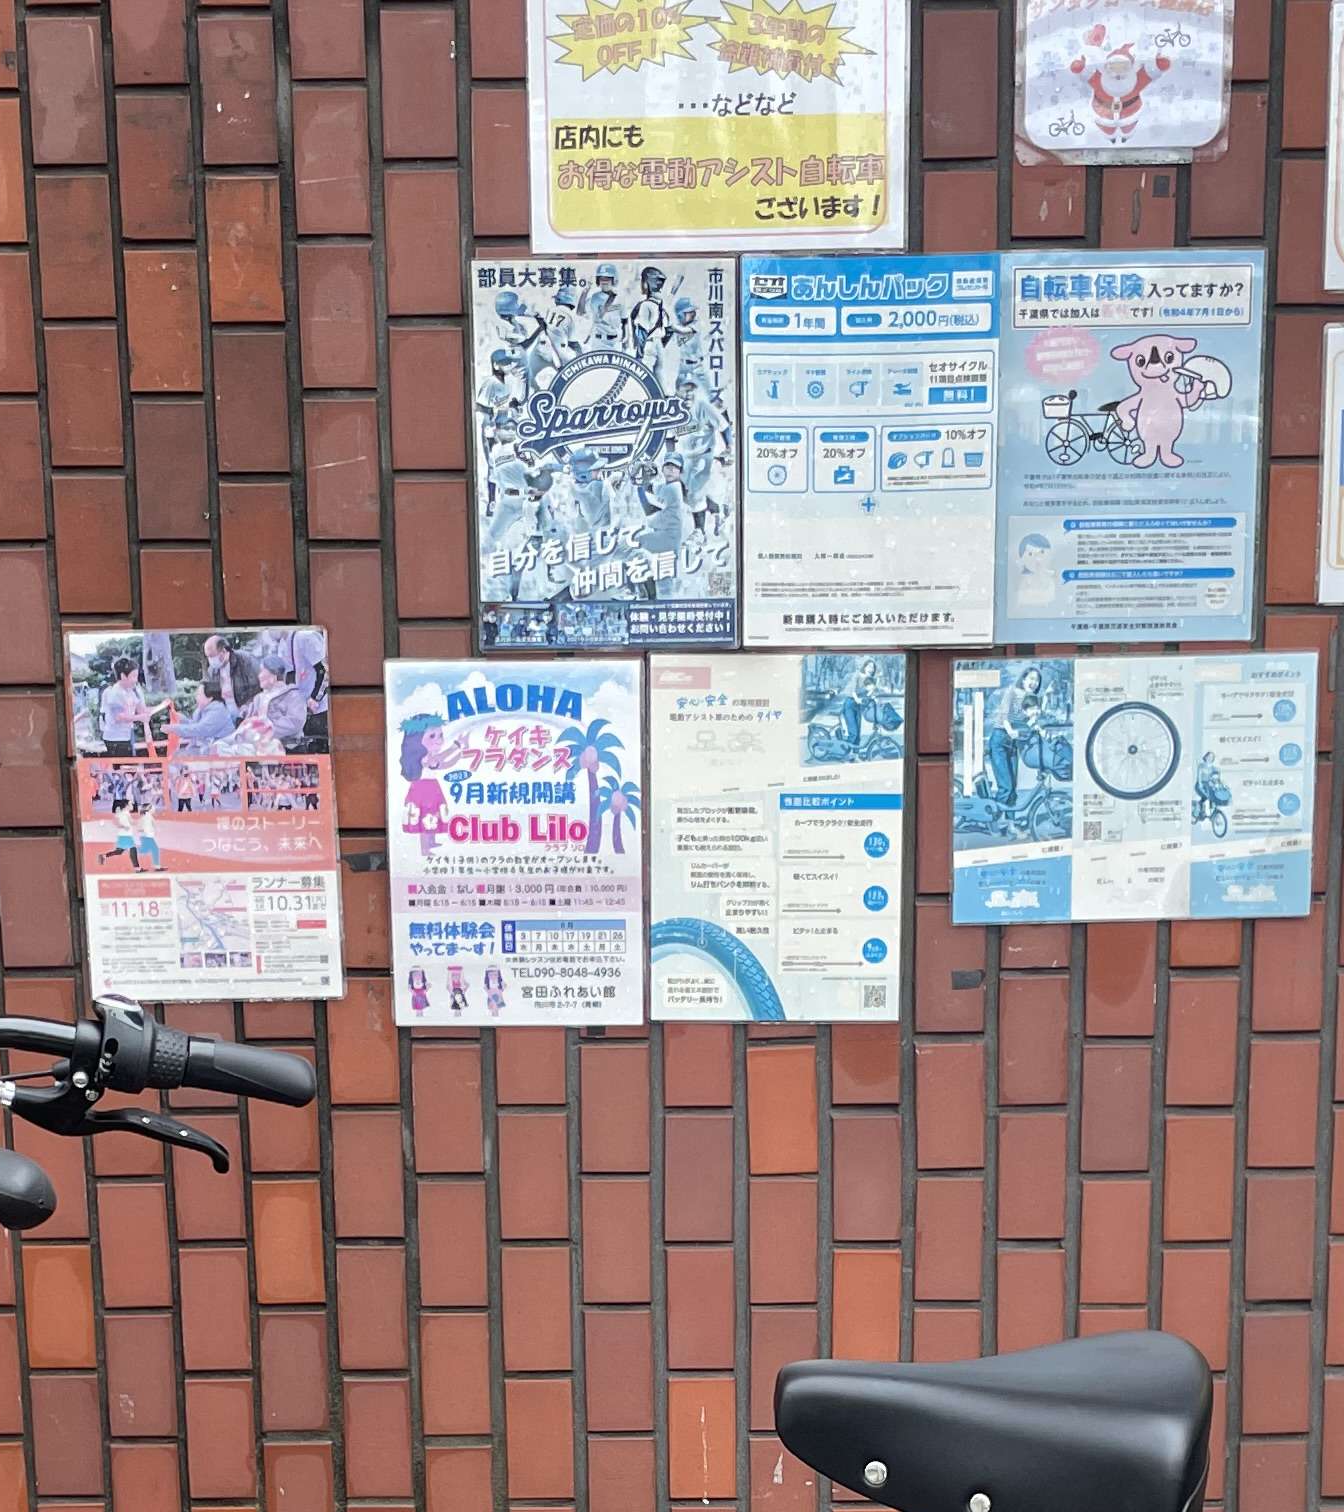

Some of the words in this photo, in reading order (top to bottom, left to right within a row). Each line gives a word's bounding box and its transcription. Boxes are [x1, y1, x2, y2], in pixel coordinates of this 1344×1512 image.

[555, 125, 644, 150] 店内にも
[558, 155, 888, 190] お得な電動アシスト自転車
[755, 195, 881, 221] ございます！
[478, 268, 588, 289] 部員大募集。
[791, 273, 949, 301] あんしんパック
[1020, 274, 1145, 302] 自転車保険
[1147, 283, 1244, 298] 入ってますか?
[794, 313, 825, 329] 1年間
[888, 311, 980, 328] 2,000円(税込)
[707, 268, 724, 403] 市川南スパローズ
[561, 355, 608, 381] ICHIKAWA
[612, 356, 648, 381] MINAMI
[929, 361, 987, 372] セオサイクル
[518, 392, 691, 440] Sparrows
[945, 429, 987, 440] 10%オフ
[757, 448, 798, 458] 20%オフ
[823, 448, 866, 459] 20%オフ
[487, 524, 644, 578] 自分を信じて
[571, 544, 730, 597] 仲間を信じて
[446, 684, 583, 722] ALOHA
[484, 726, 553, 748] ケイキ
[462, 747, 573, 773] フラダンス
[450, 782, 576, 804] 9月新規開講
[448, 815, 520, 843] Club
[528, 814, 588, 843] Lilo
[111, 901, 159, 918] 11.18
[268, 896, 311, 911] 10.31
[409, 922, 495, 940] 無料体験会
[551, 932, 559, 940] 10
[566, 932, 574, 940] 17
[582, 932, 590, 940] 19
[598, 932, 606, 940] 21
[613, 932, 623, 940] 26
[512, 967, 621, 978] TEL090-8048-4936
[521, 986, 616, 999] 宮田ふれあい館
